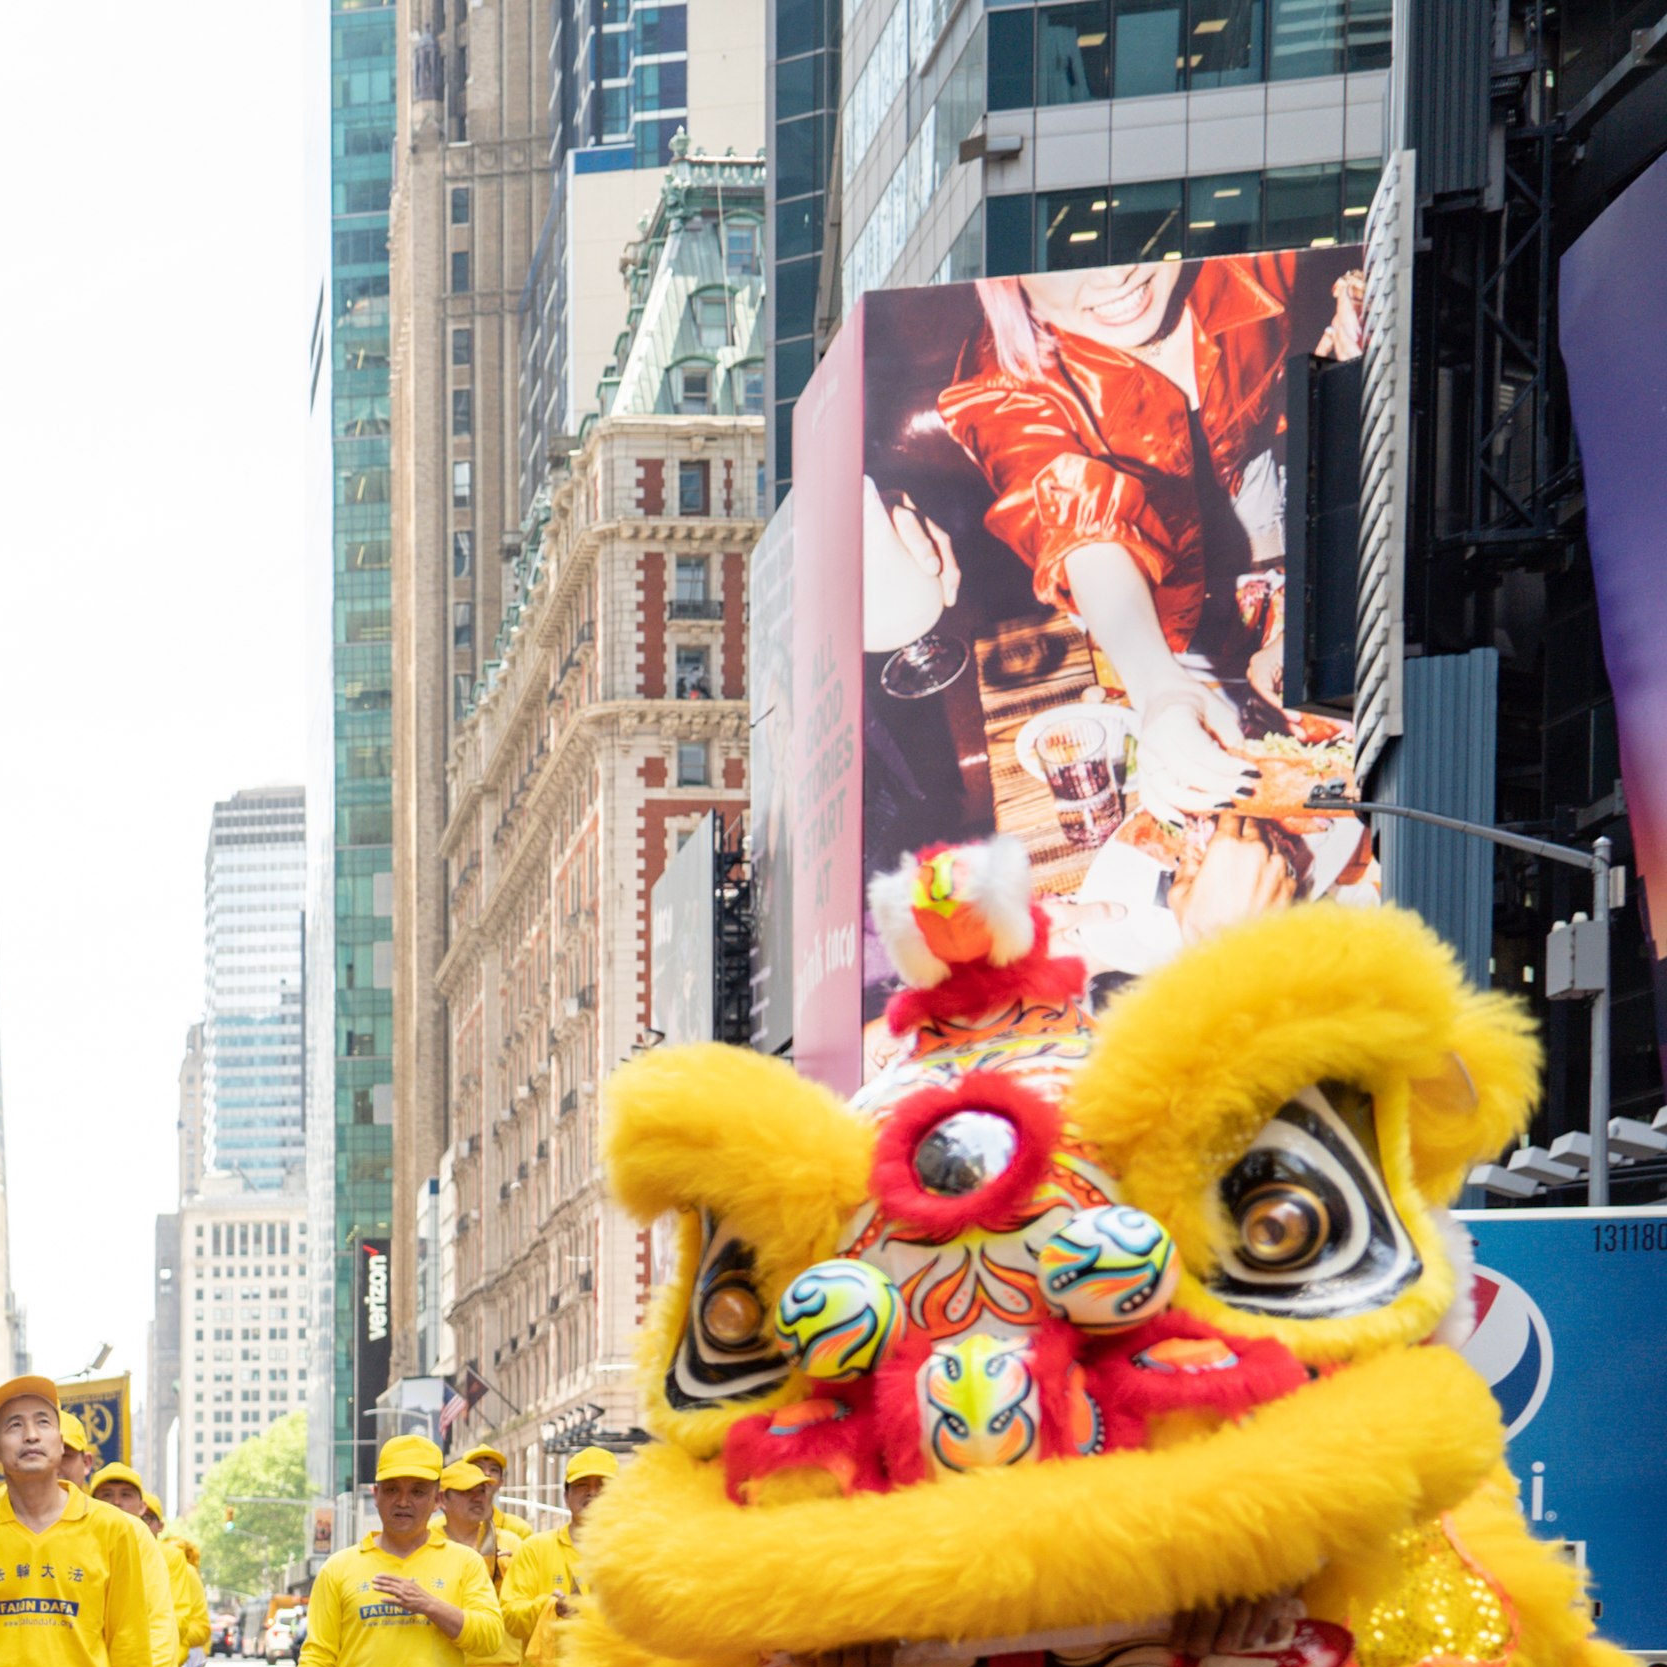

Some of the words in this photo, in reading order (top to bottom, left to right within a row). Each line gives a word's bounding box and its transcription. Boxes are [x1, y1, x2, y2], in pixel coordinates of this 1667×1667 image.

[811, 633, 836, 700] ALL
[805, 678, 844, 760] GOOD
[797, 722, 855, 823] STORIES
[801, 786, 848, 873] START
[816, 857, 833, 909] AT
[363, 1255, 388, 1342] verizon
[39, 1601, 75, 1615] DAFA
[362, 1605, 404, 1618] FALUN
